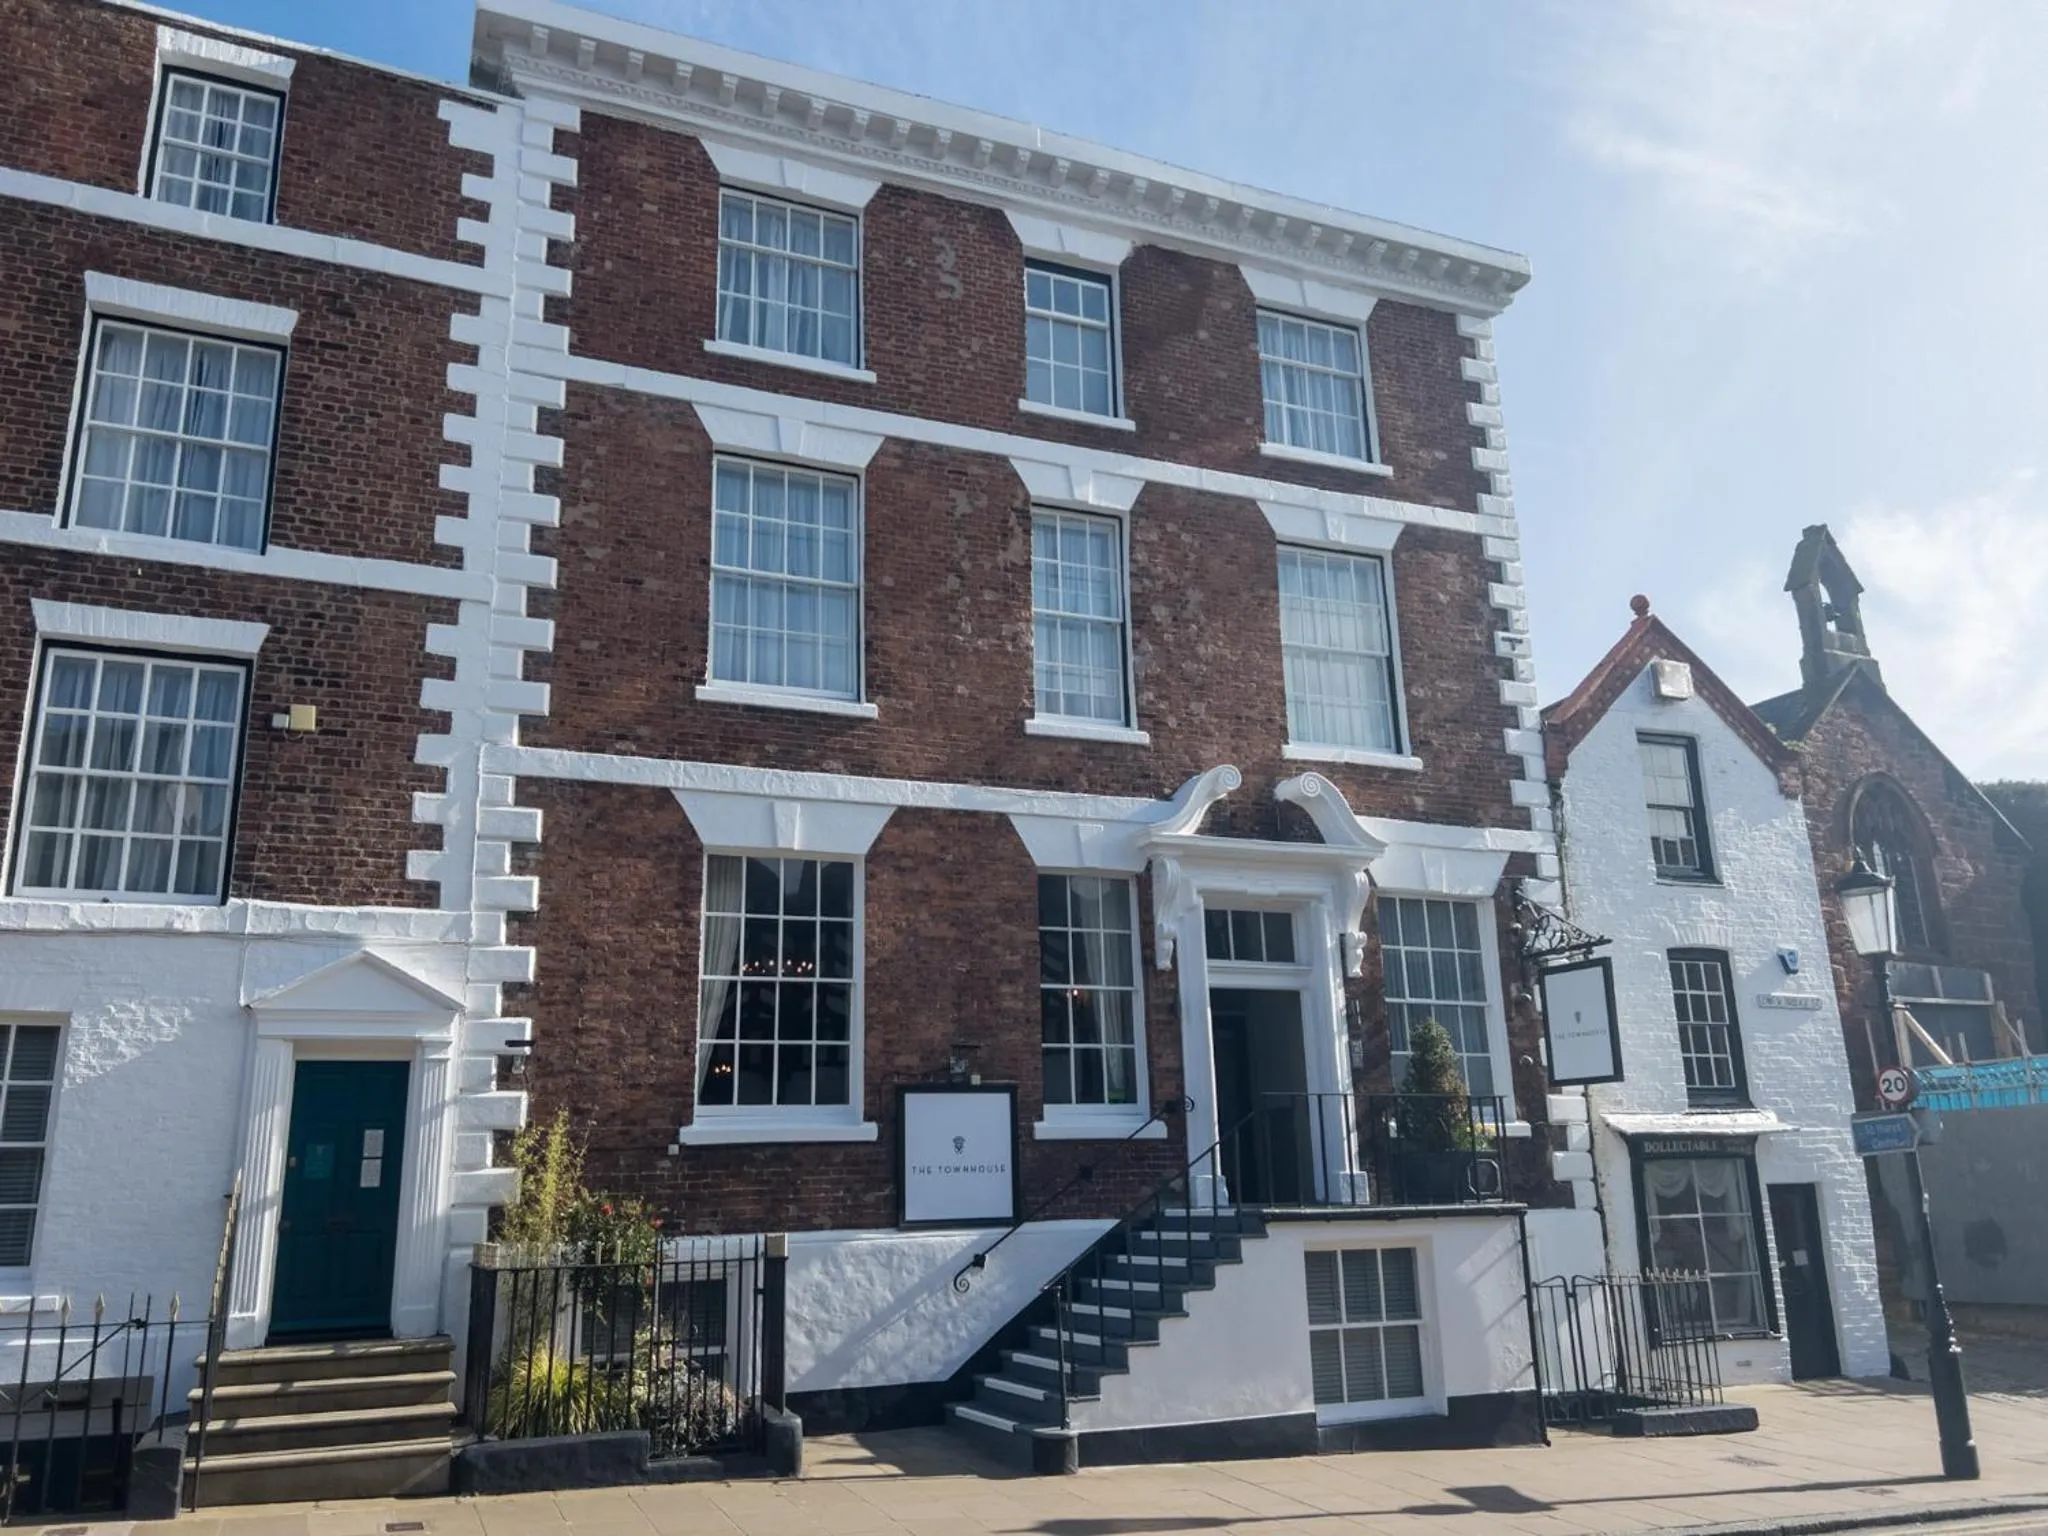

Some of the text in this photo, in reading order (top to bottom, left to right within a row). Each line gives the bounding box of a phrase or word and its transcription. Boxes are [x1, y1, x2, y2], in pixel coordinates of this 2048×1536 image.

[1882, 1077, 1905, 1093] 20
[911, 1163, 1006, 1175] THE TOWNHOUSE
